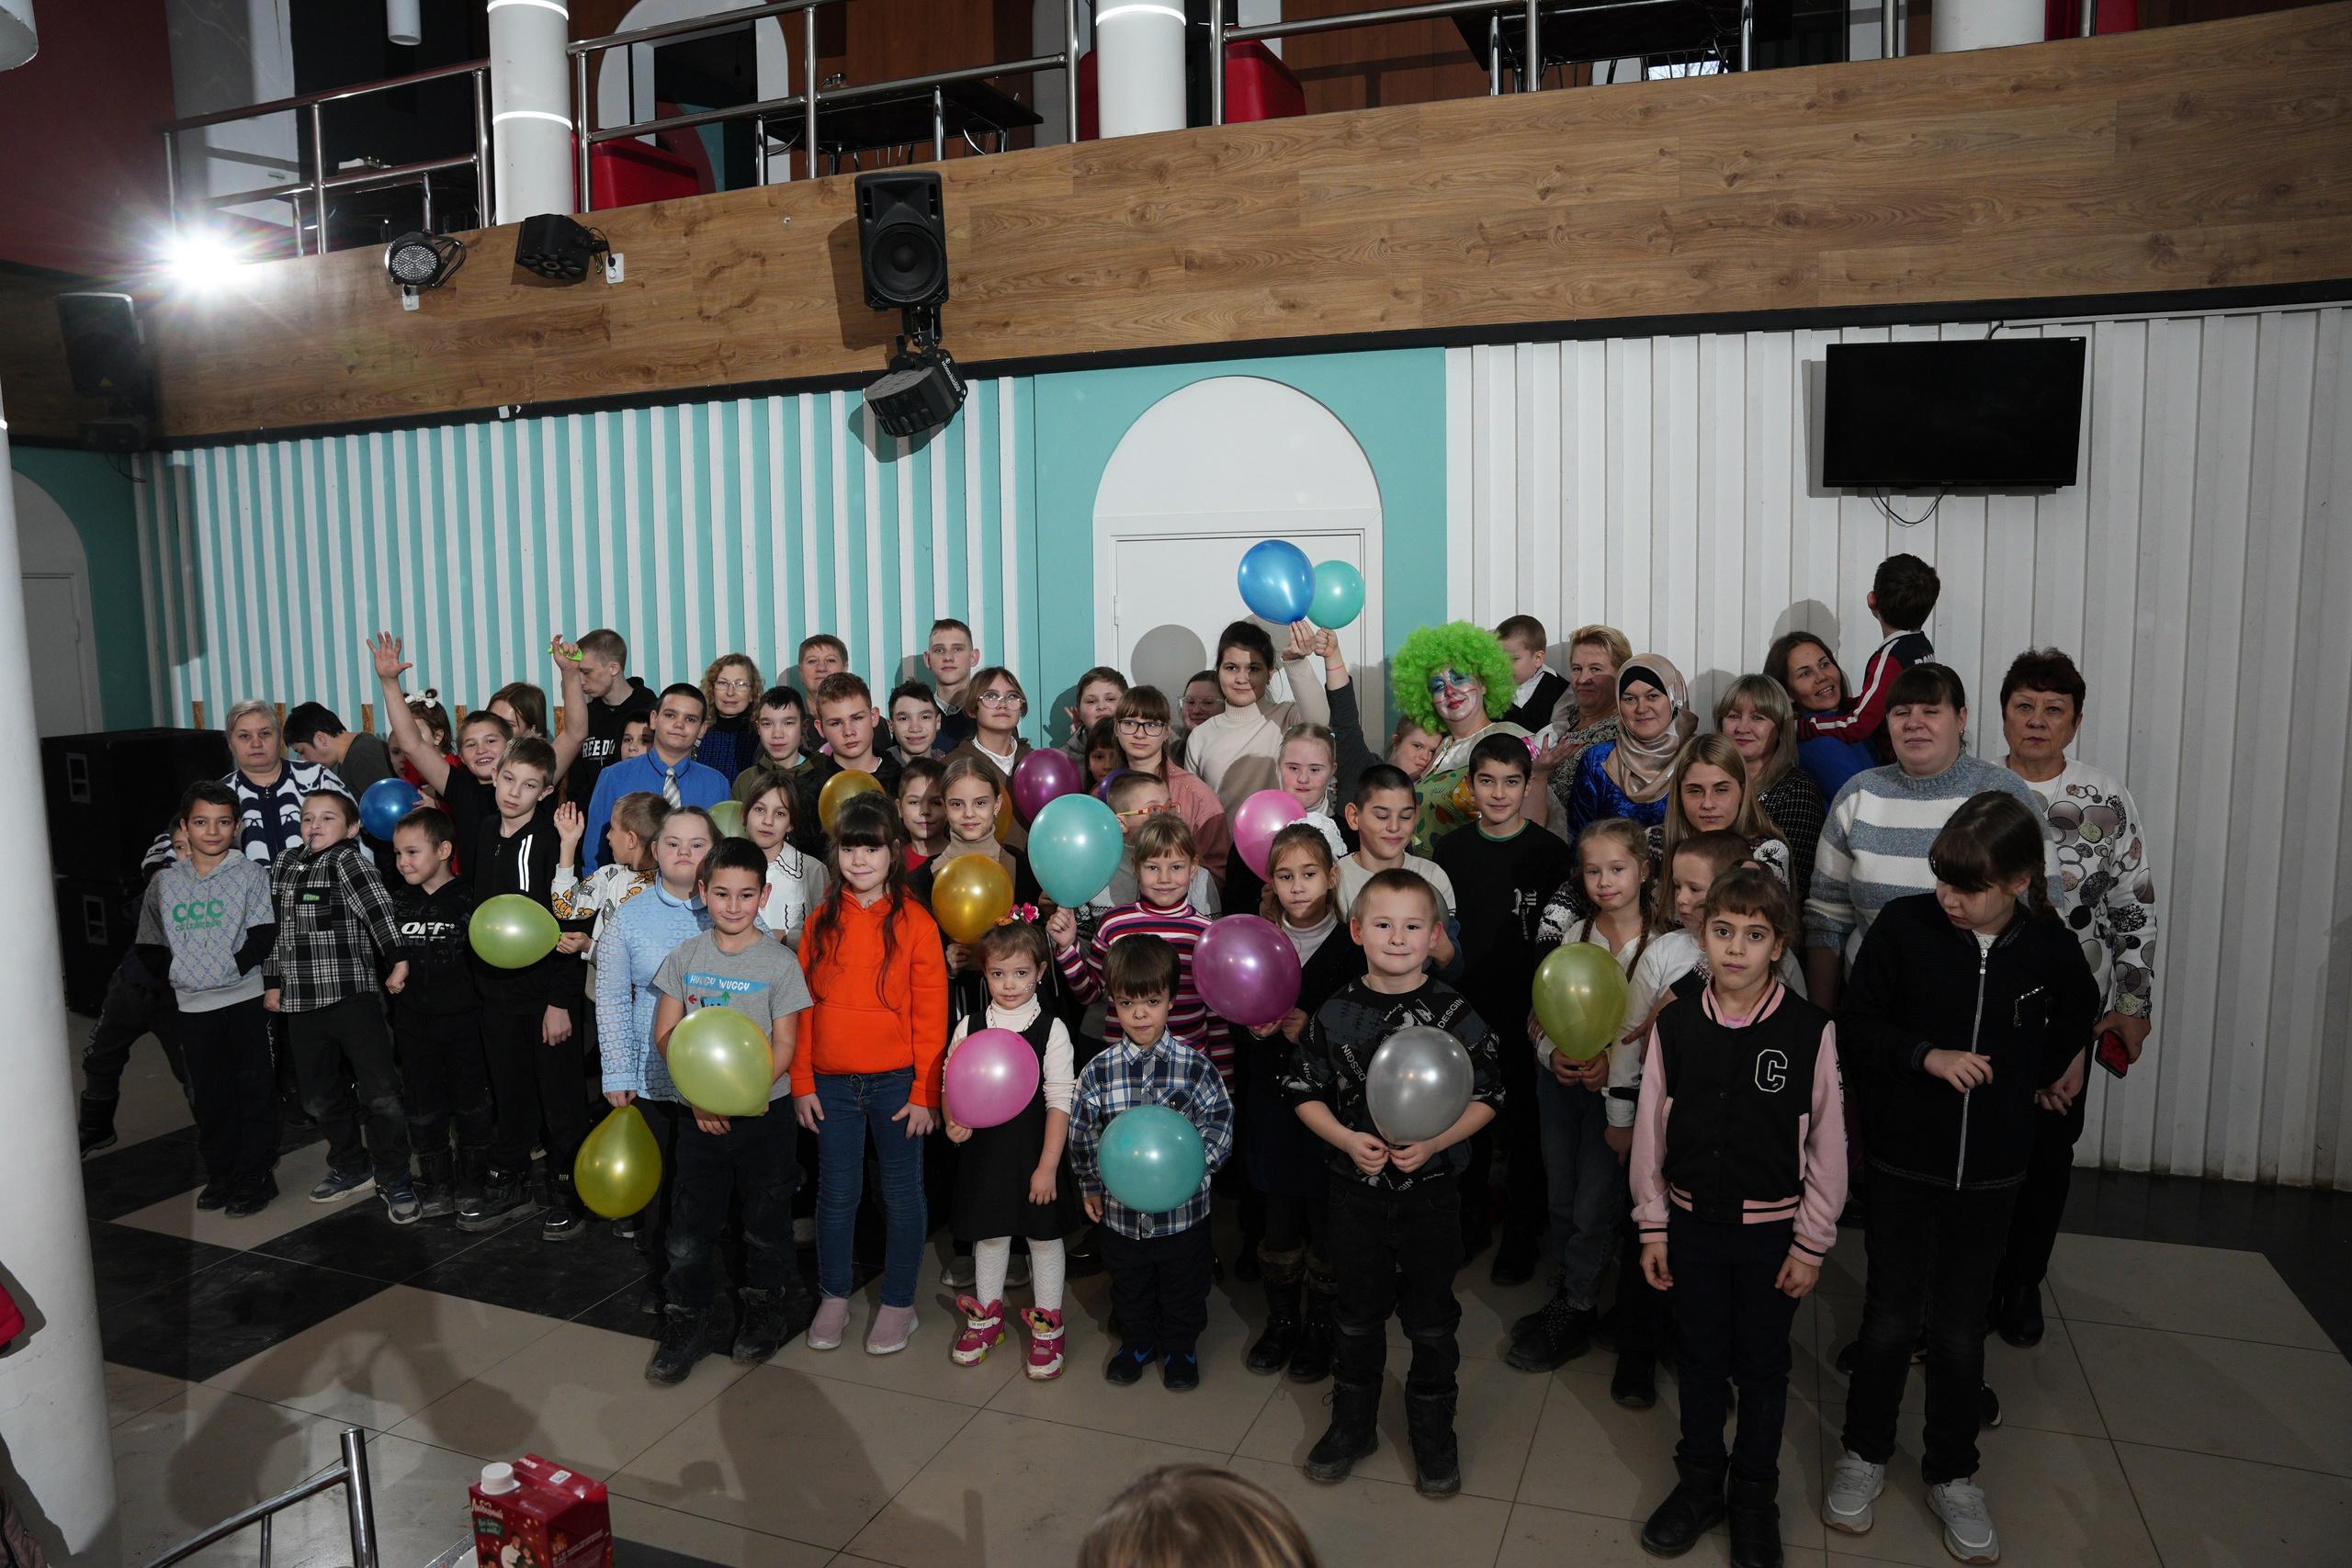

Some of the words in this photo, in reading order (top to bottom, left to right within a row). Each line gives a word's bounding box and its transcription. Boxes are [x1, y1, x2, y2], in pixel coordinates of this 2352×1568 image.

[582, 739, 616, 759] REEDO
[173, 900, 224, 922] CCC
[718, 978, 751, 992] WUGGY
[1437, 998, 1464, 1029] DESGIN
[1341, 1043, 1367, 1082] DESGIN
[1755, 1049, 1788, 1093] C
[1397, 1178, 1414, 1191] GIN
